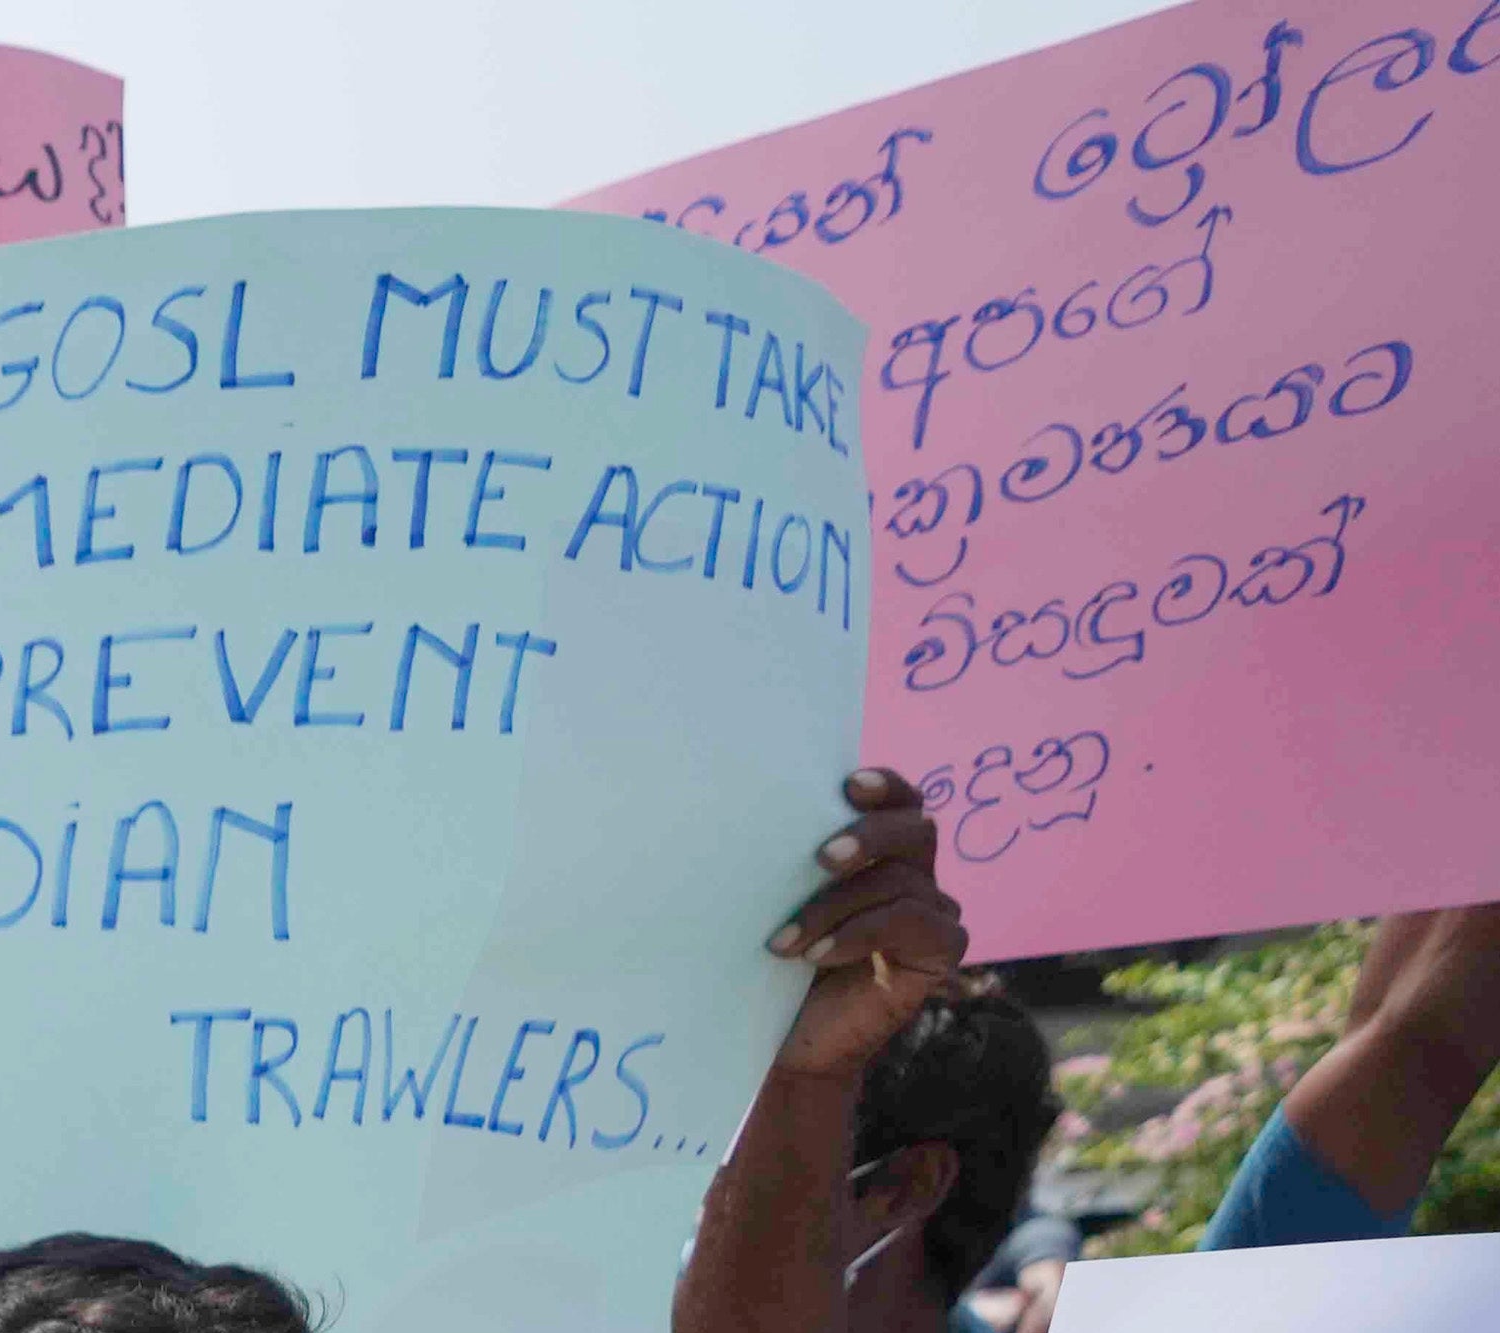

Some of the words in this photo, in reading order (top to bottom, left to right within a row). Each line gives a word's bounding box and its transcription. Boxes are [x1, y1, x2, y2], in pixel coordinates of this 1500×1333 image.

[360, 271, 684, 398] MUST
[705, 310, 849, 458] TAKE
[563, 464, 854, 634] ACTION
